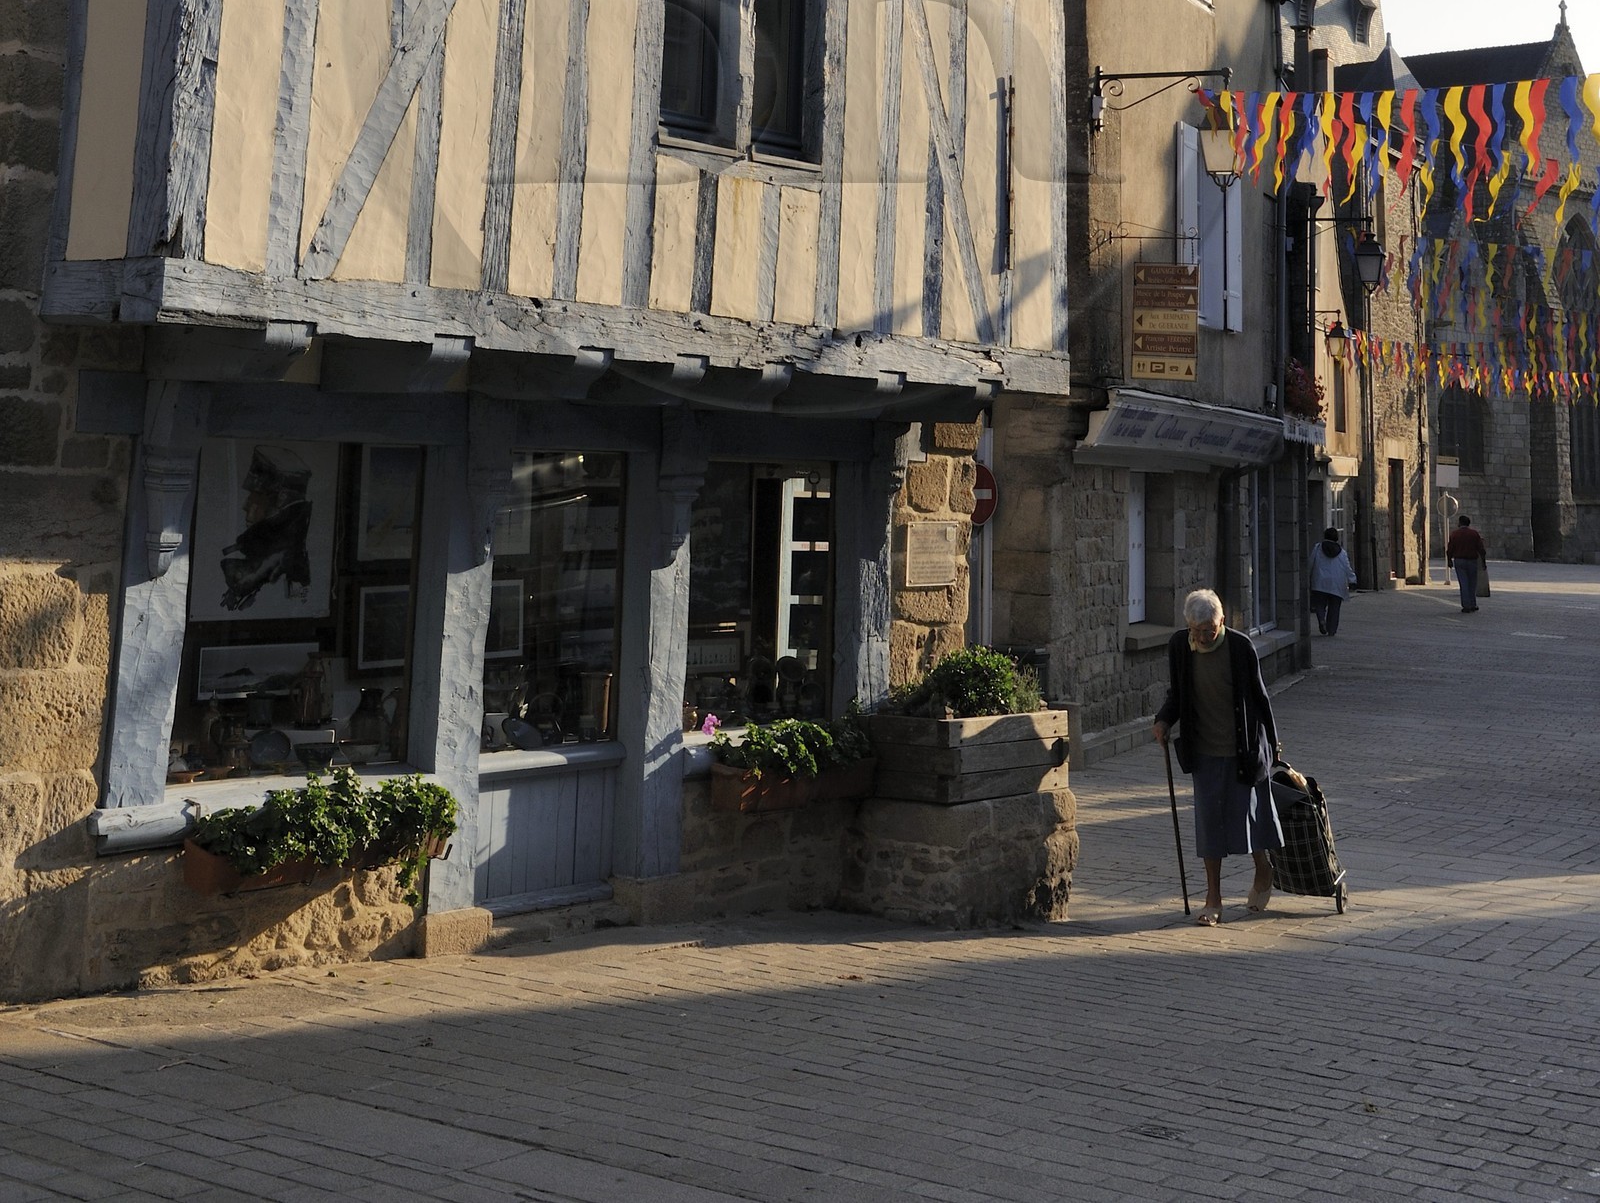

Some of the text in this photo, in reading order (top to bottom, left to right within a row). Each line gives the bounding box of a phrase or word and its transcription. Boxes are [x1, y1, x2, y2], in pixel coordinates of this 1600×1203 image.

[1151, 267, 1175, 275] GAINAGE
[1161, 290, 1166, 298] la
[1167, 291, 1186, 299] Poupée
[1163, 313, 1190, 321] REMPARTS
[1145, 344, 1192, 353] Artiste Peintre
